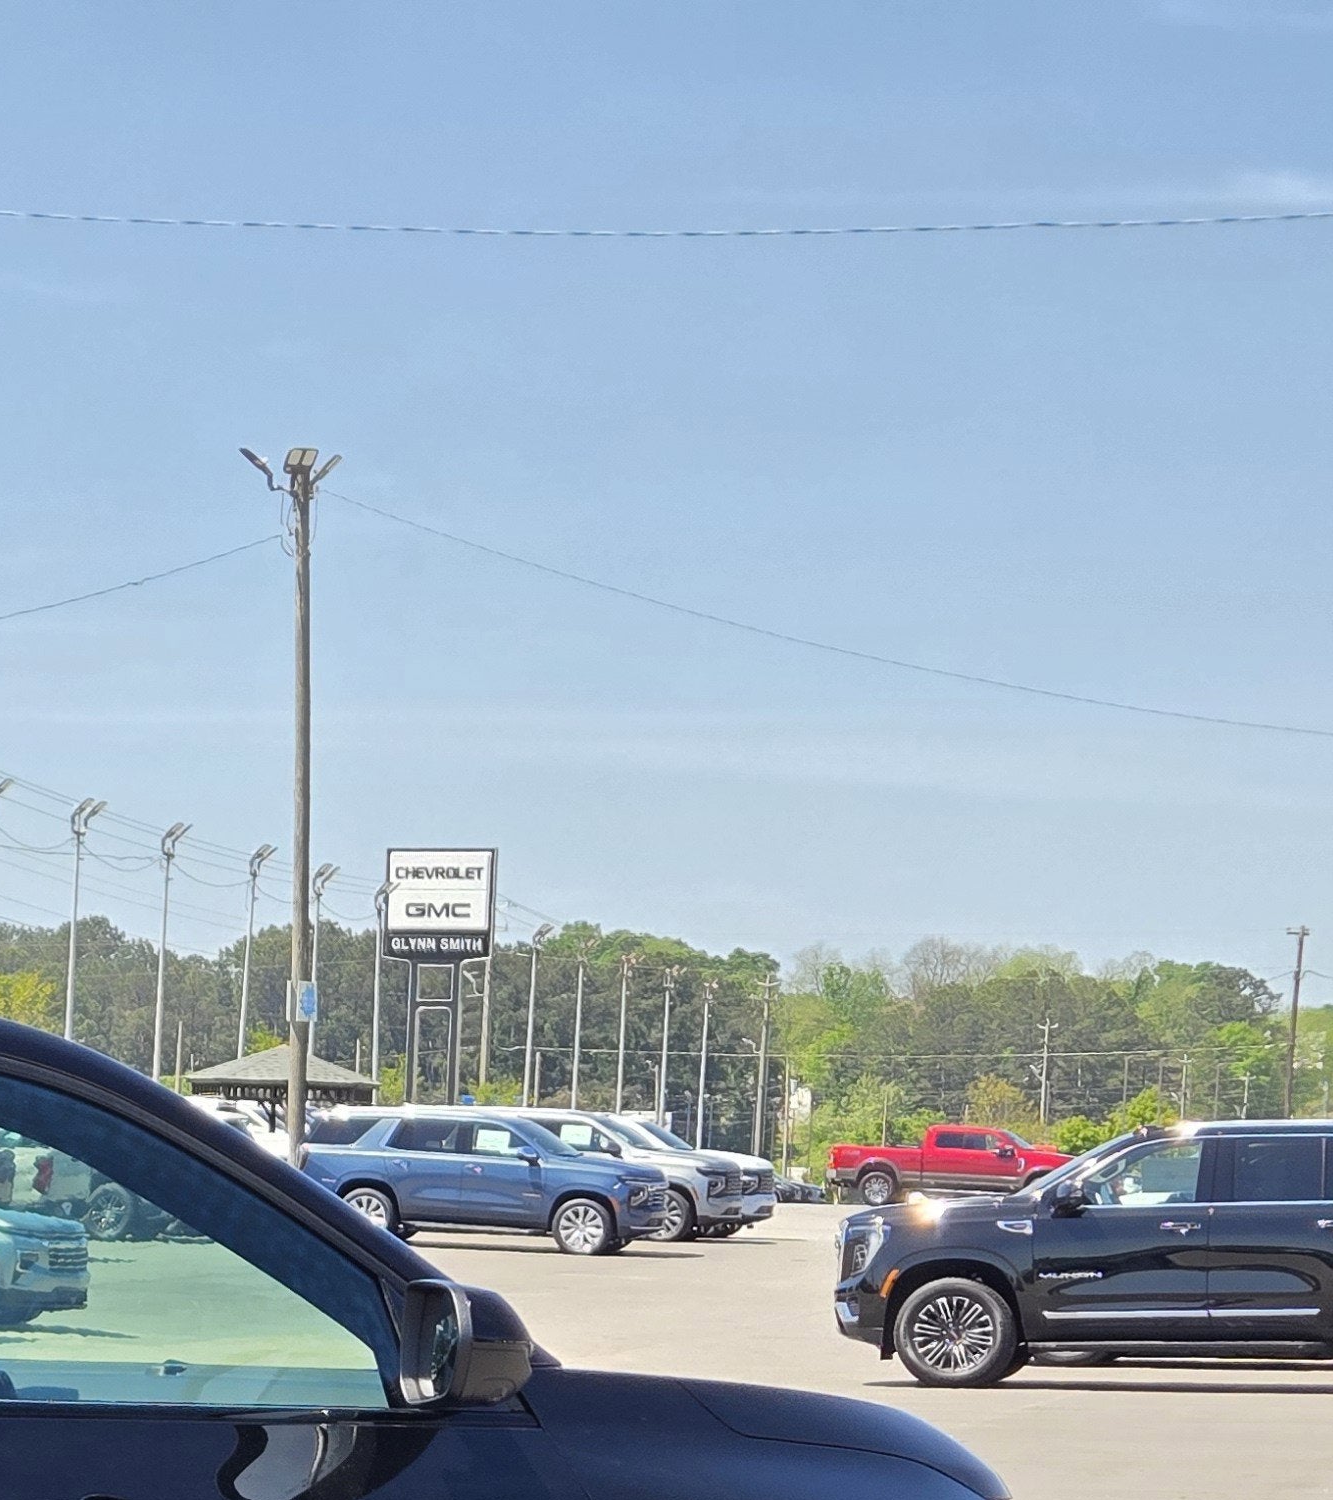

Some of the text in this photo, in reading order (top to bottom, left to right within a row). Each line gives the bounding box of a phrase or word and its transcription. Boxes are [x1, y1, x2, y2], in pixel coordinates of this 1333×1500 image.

[395, 867, 484, 879] CHEVROLET
[405, 903, 471, 917] GMC
[391, 937, 483, 951] GLYNN SMITH
